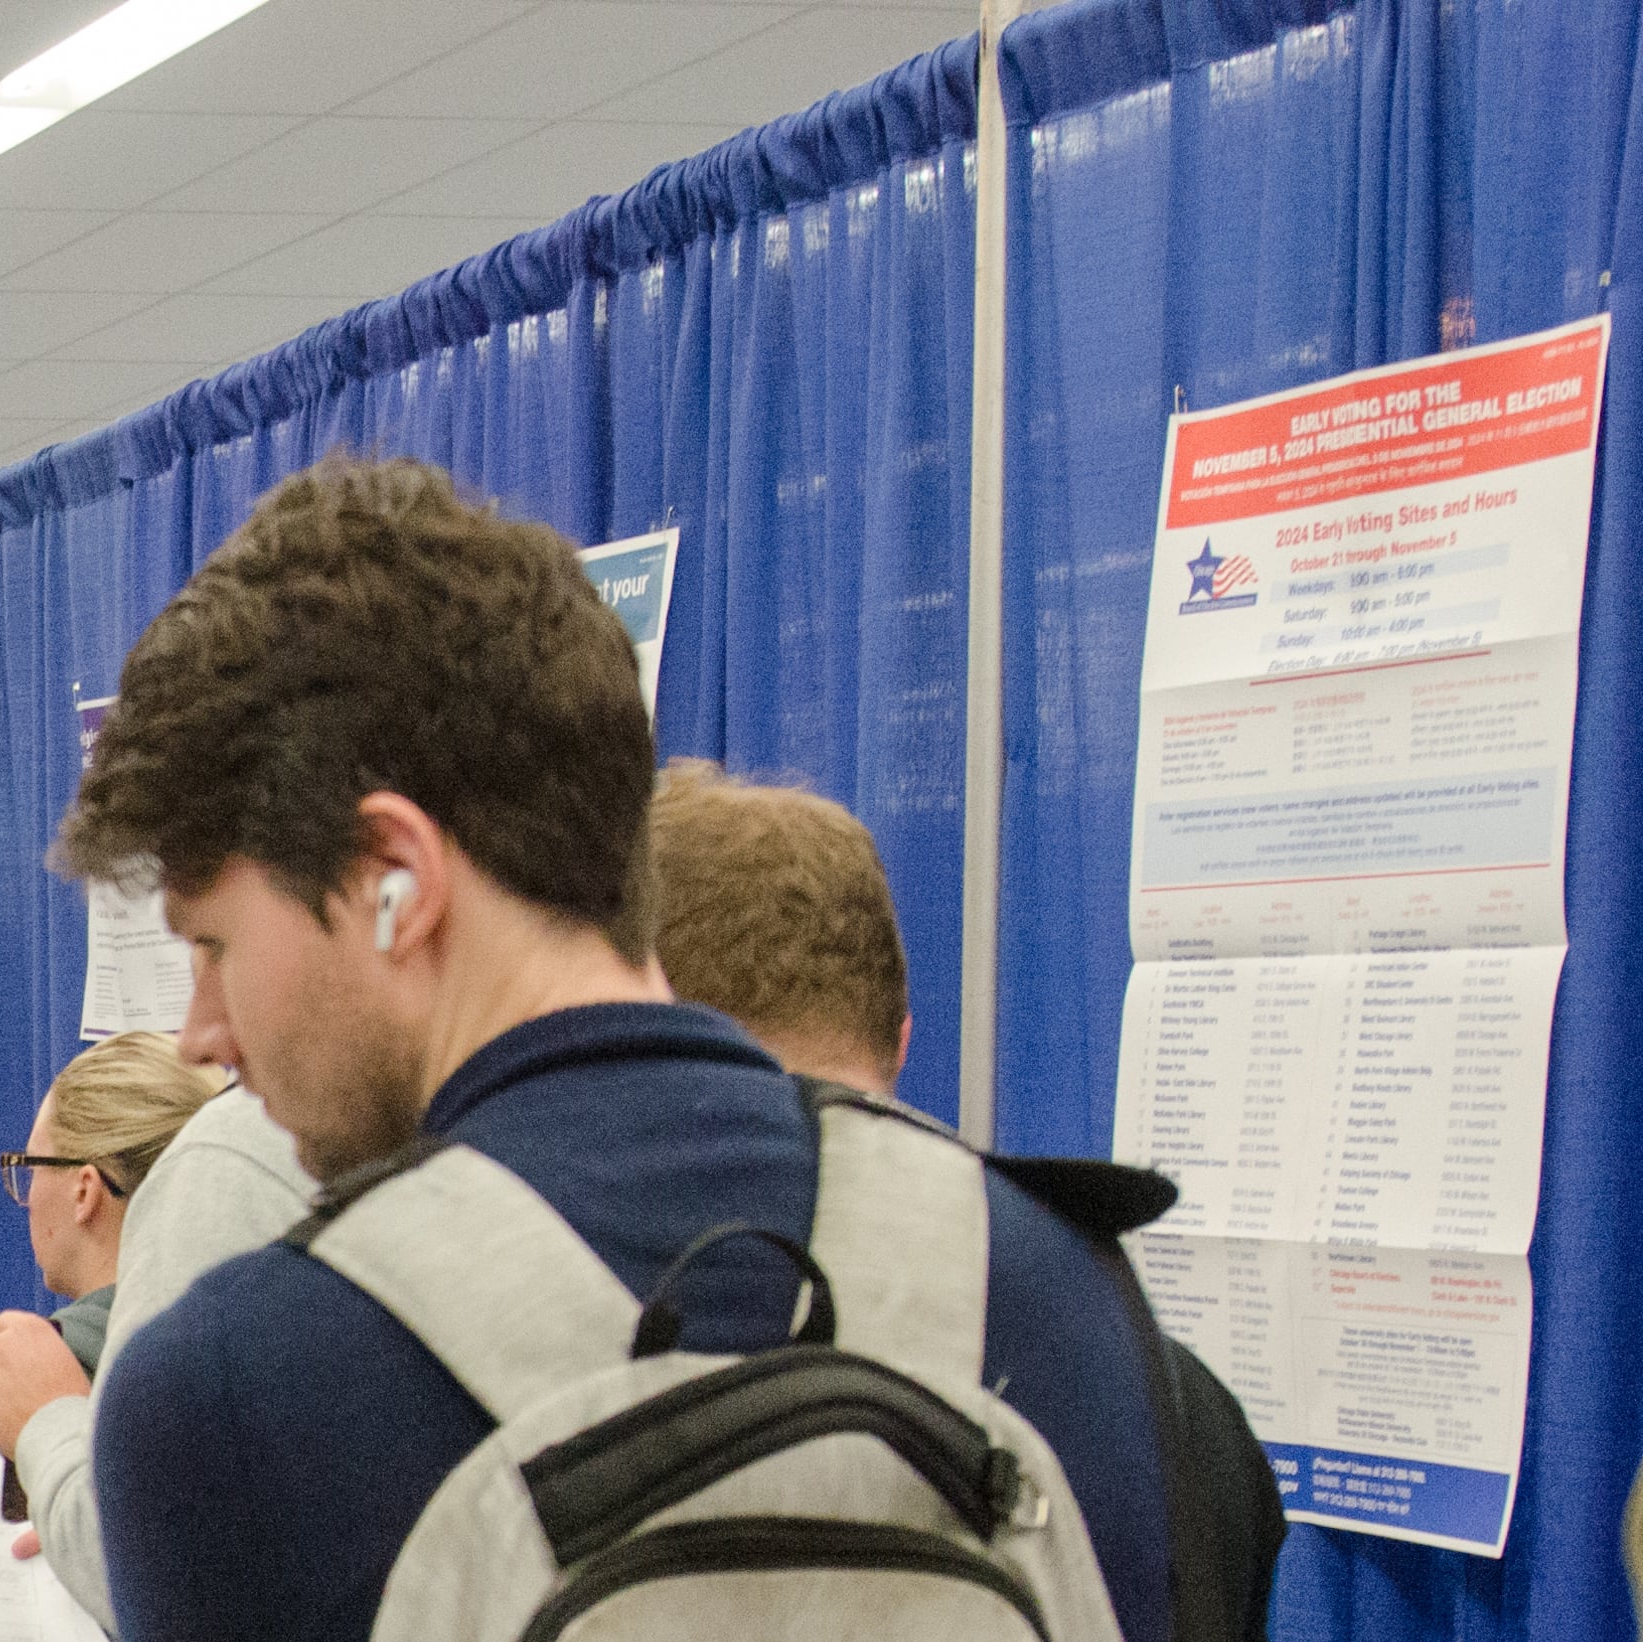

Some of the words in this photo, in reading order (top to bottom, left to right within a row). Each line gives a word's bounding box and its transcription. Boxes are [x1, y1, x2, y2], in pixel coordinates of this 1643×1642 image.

[1192, 447, 1267, 480] NOVEMBER
[1268, 446, 1283, 466] 5,
[1284, 437, 1315, 463] 2024
[1315, 417, 1419, 453] PRESIDENTIAL
[1421, 398, 1503, 432] GENERAL
[1504, 376, 1584, 414] ELECTION
[1291, 411, 1330, 438] EARLY
[1332, 397, 1382, 428] VOTING
[1384, 387, 1422, 415] FOR
[1424, 380, 1461, 409] THE
[1275, 527, 1309, 549] 2024
[1314, 519, 1345, 544] Early
[1345, 511, 1394, 535] Voting
[1398, 505, 1438, 526] Sites
[1442, 499, 1470, 517] and
[1475, 488, 1519, 512] Hours
[1290, 555, 1330, 574] October
[1332, 552, 1343, 568] 21
[1391, 536, 1447, 559] November
[1450, 531, 1458, 547] 5
[612, 574, 650, 606] your
